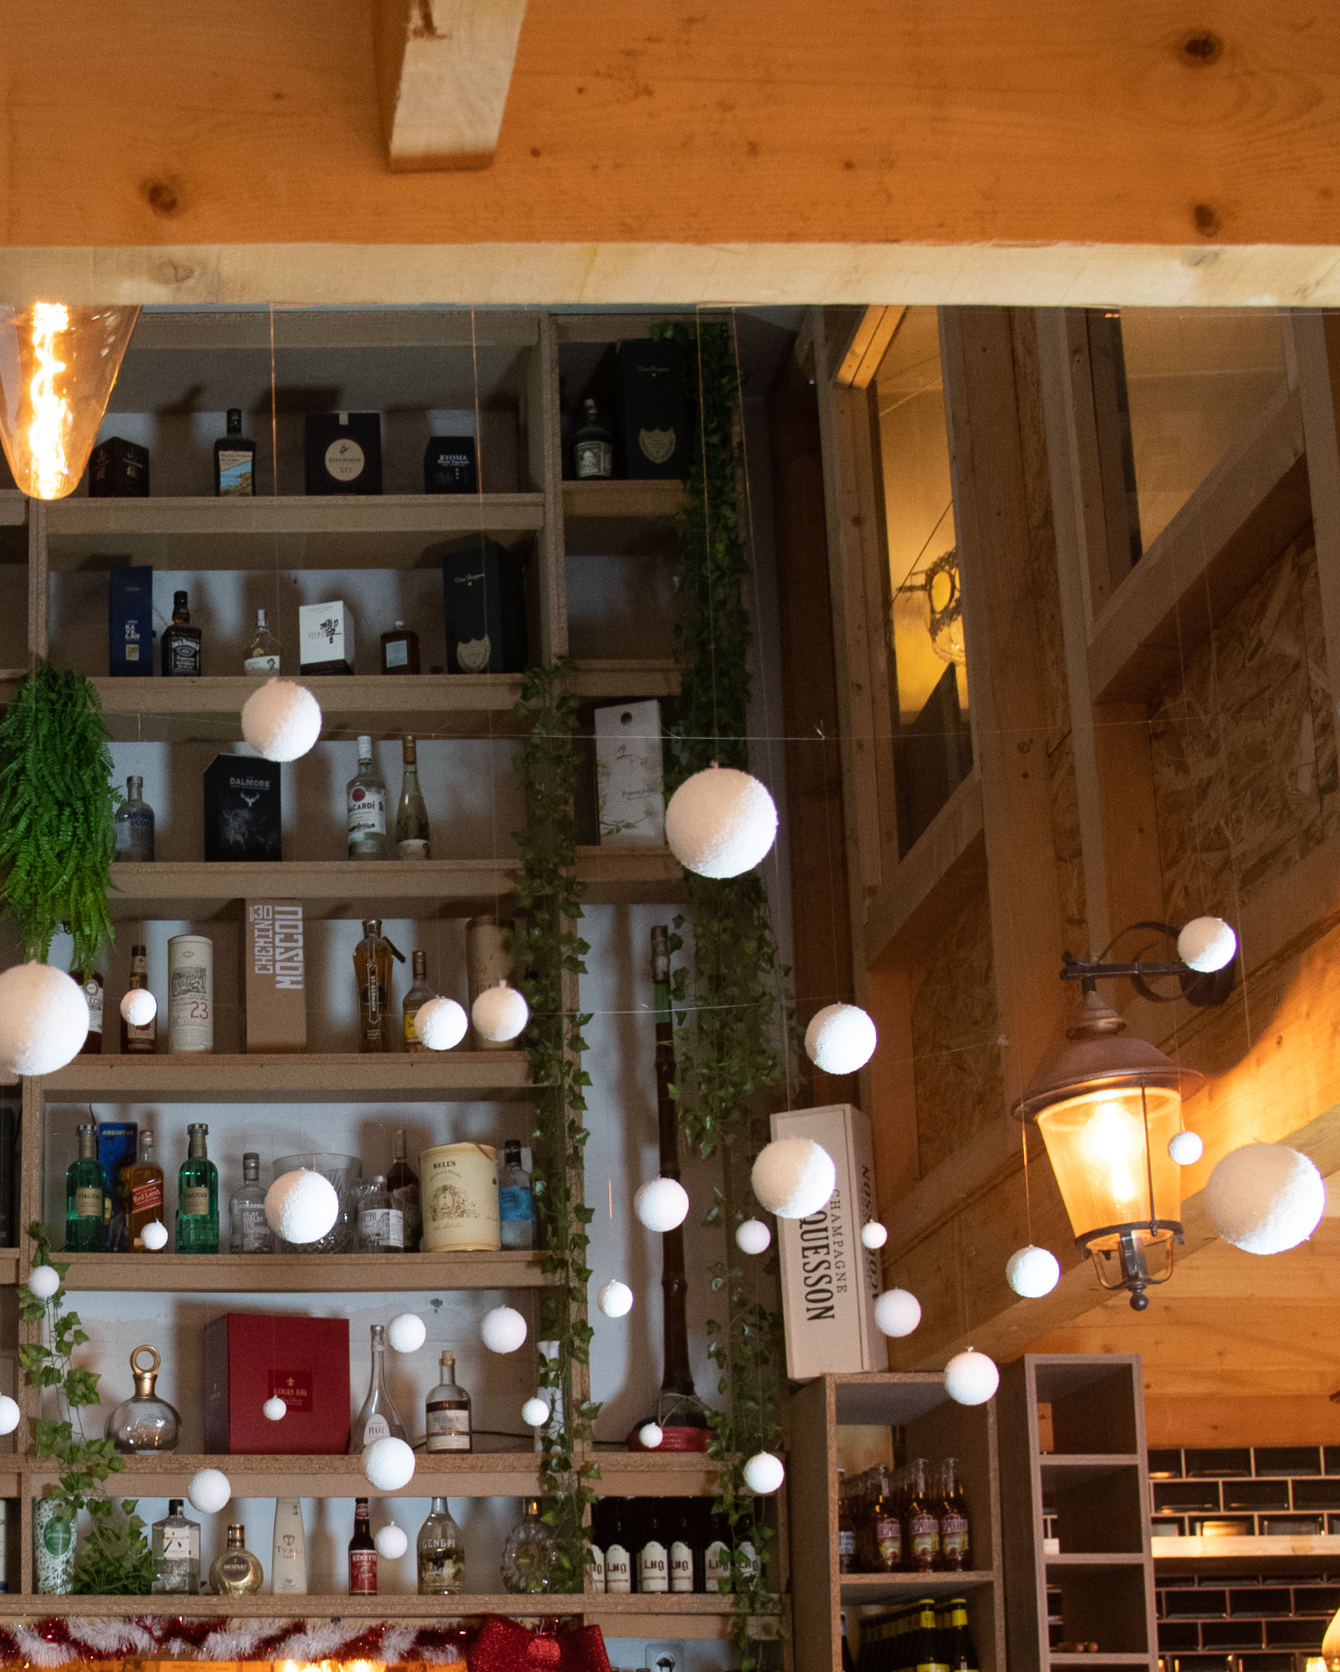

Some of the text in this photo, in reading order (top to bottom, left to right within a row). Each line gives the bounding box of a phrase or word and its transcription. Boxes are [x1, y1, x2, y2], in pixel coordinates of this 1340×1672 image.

[230, 777, 270, 788] DALMORE
[254, 920, 273, 974] CHEMIN
[275, 906, 304, 989] MOSCOU
[190, 1001, 209, 1019] 23
[433, 1160, 456, 1170] BELL'S
[830, 1189, 847, 1293] CHAMPAGNE
[799, 1210, 836, 1322] QUESSON
[274, 1388, 295, 1396] LOUIS
